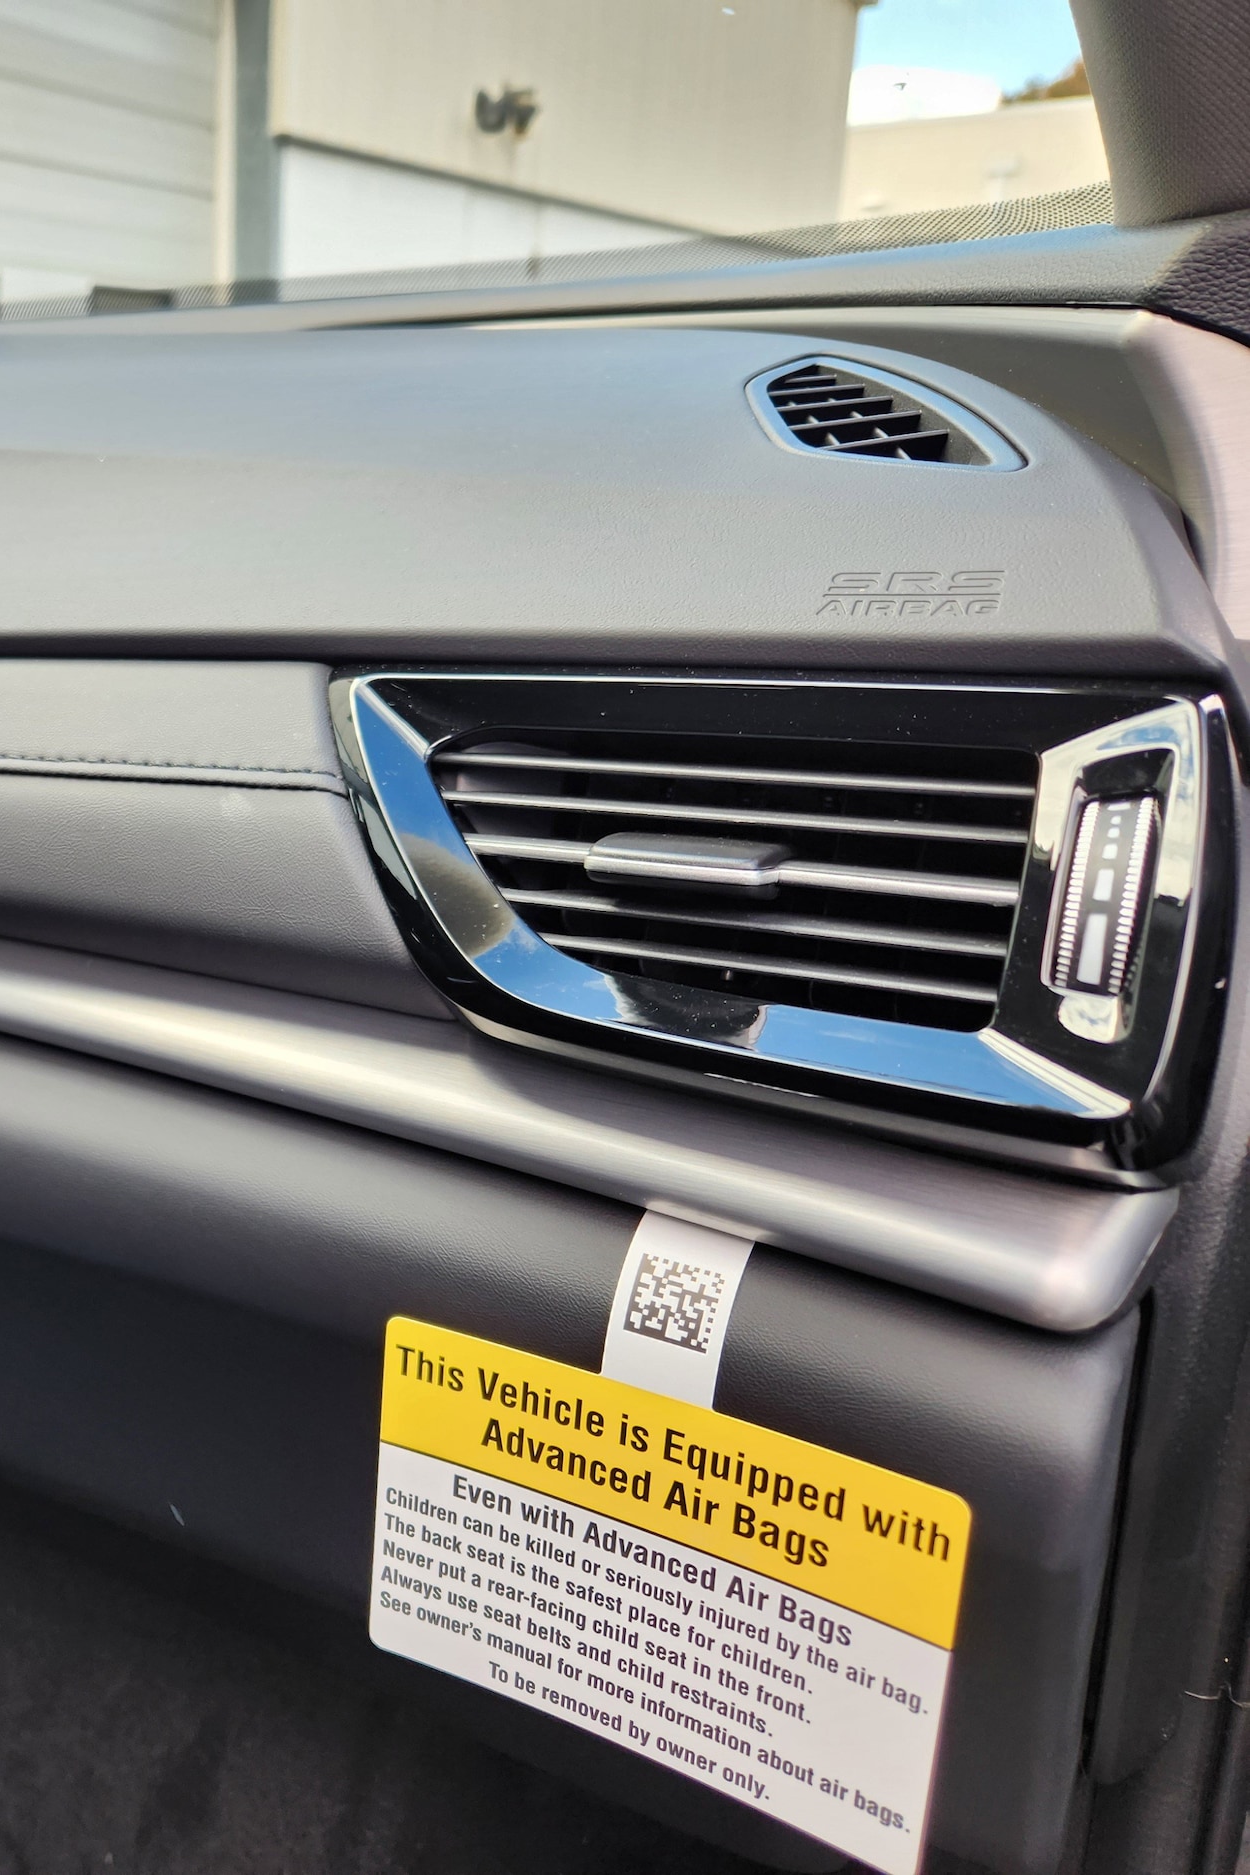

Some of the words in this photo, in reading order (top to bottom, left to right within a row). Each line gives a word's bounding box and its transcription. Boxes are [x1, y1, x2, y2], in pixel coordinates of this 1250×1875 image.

[815, 599, 1000, 616] AIRBAG
[827, 571, 1005, 592] SRS
[396, 1345, 464, 1392] This
[478, 1367, 604, 1437] Vehicle
[619, 1413, 649, 1452] is
[663, 1428, 846, 1522] Equipped
[863, 1504, 950, 1561] with
[481, 1418, 651, 1503] Advanced
[663, 1480, 720, 1525] Air
[732, 1502, 829, 1567] Bags
[383, 1539, 434, 1570] Never
[439, 1561, 466, 1583] put
[471, 1573, 481, 1588] a
[488, 1579, 586, 1631] rear-facing
[592, 1619, 639, 1649] child
[644, 1641, 687, 1670] seat
[693, 1657, 711, 1680] in
[718, 1668, 749, 1696] the
[757, 1685, 810, 1724] front.
[384, 1513, 415, 1538] The
[422, 1525, 462, 1554] back
[467, 1544, 505, 1570] seat
[511, 1556, 526, 1577] is
[531, 1564, 559, 1589] the
[565, 1581, 622, 1615] safest
[628, 1605, 680, 1637] place
[687, 1626, 715, 1651] for
[721, 1643, 812, 1694] children.
[386, 1488, 457, 1525] Children
[463, 1516, 493, 1538] can
[499, 1524, 520, 1547] be
[526, 1534, 576, 1568] killed
[582, 1559, 601, 1576] or
[605, 1568, 693, 1616] seriously
[699, 1600, 770, 1645] injured
[776, 1632, 800, 1660] by
[807, 1645, 838, 1673] the
[846, 1666, 875, 1688] air
[882, 1677, 927, 1713] bag.
[453, 1474, 511, 1515] Even
[521, 1502, 574, 1538] with
[582, 1521, 716, 1592] Advanced
[725, 1575, 769, 1611] Air
[779, 1594, 852, 1646] Bags
[380, 1591, 411, 1615] See
[487, 1633, 552, 1670] manual
[557, 1657, 583, 1681] for
[587, 1673, 634, 1704] more
[641, 1692, 751, 1757] information
[757, 1749, 814, 1786] about
[820, 1778, 848, 1800] air
[854, 1790, 909, 1832] bags.
[381, 1566, 442, 1600] Always
[448, 1591, 478, 1613] use
[483, 1605, 522, 1630] seat
[527, 1617, 571, 1650] belts
[577, 1641, 611, 1666] and
[617, 1658, 664, 1689] child
[671, 1680, 772, 1737] restraints.
[489, 1661, 508, 1683] To
[515, 1672, 535, 1694] be
[542, 1686, 622, 1732] removed
[629, 1720, 651, 1747] by
[656, 1737, 717, 1773] owner
[723, 1767, 769, 1800] only.
